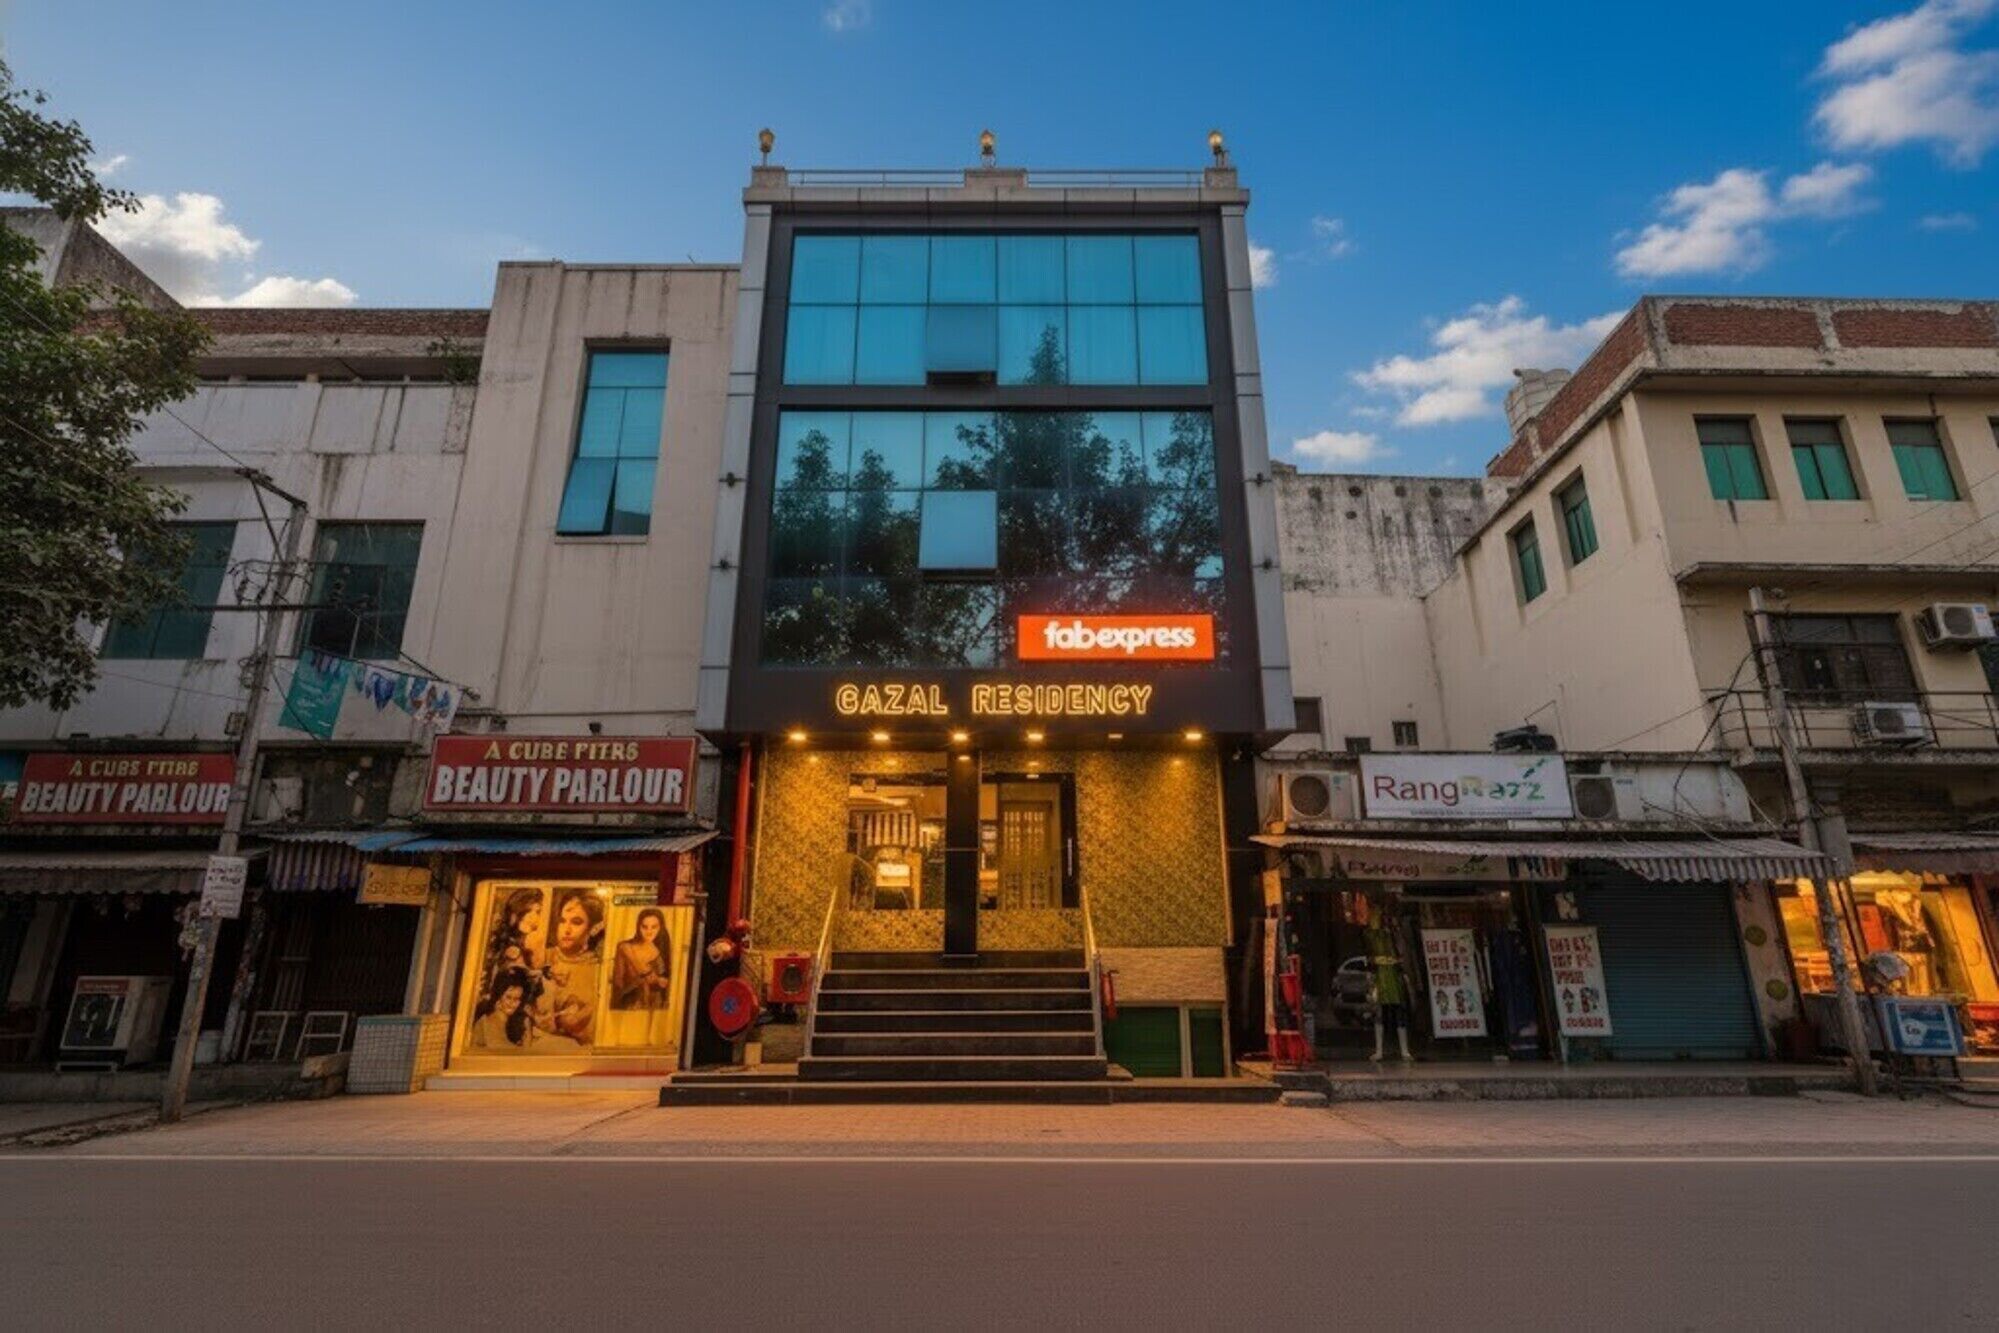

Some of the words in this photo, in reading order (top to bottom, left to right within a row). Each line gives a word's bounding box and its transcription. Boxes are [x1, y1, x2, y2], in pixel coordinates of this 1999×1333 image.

[1044, 620, 1196, 654] fabexpress
[836, 685, 948, 714] GAZAL
[971, 685, 1152, 714] RESIDENCY
[484, 741, 501, 760] A
[509, 742, 567, 760] CUBE
[69, 760, 82, 776] A
[20, 781, 119, 813] BEAUTY
[432, 765, 549, 804] BEAUTY
[551, 766, 684, 804] PARLOUR
